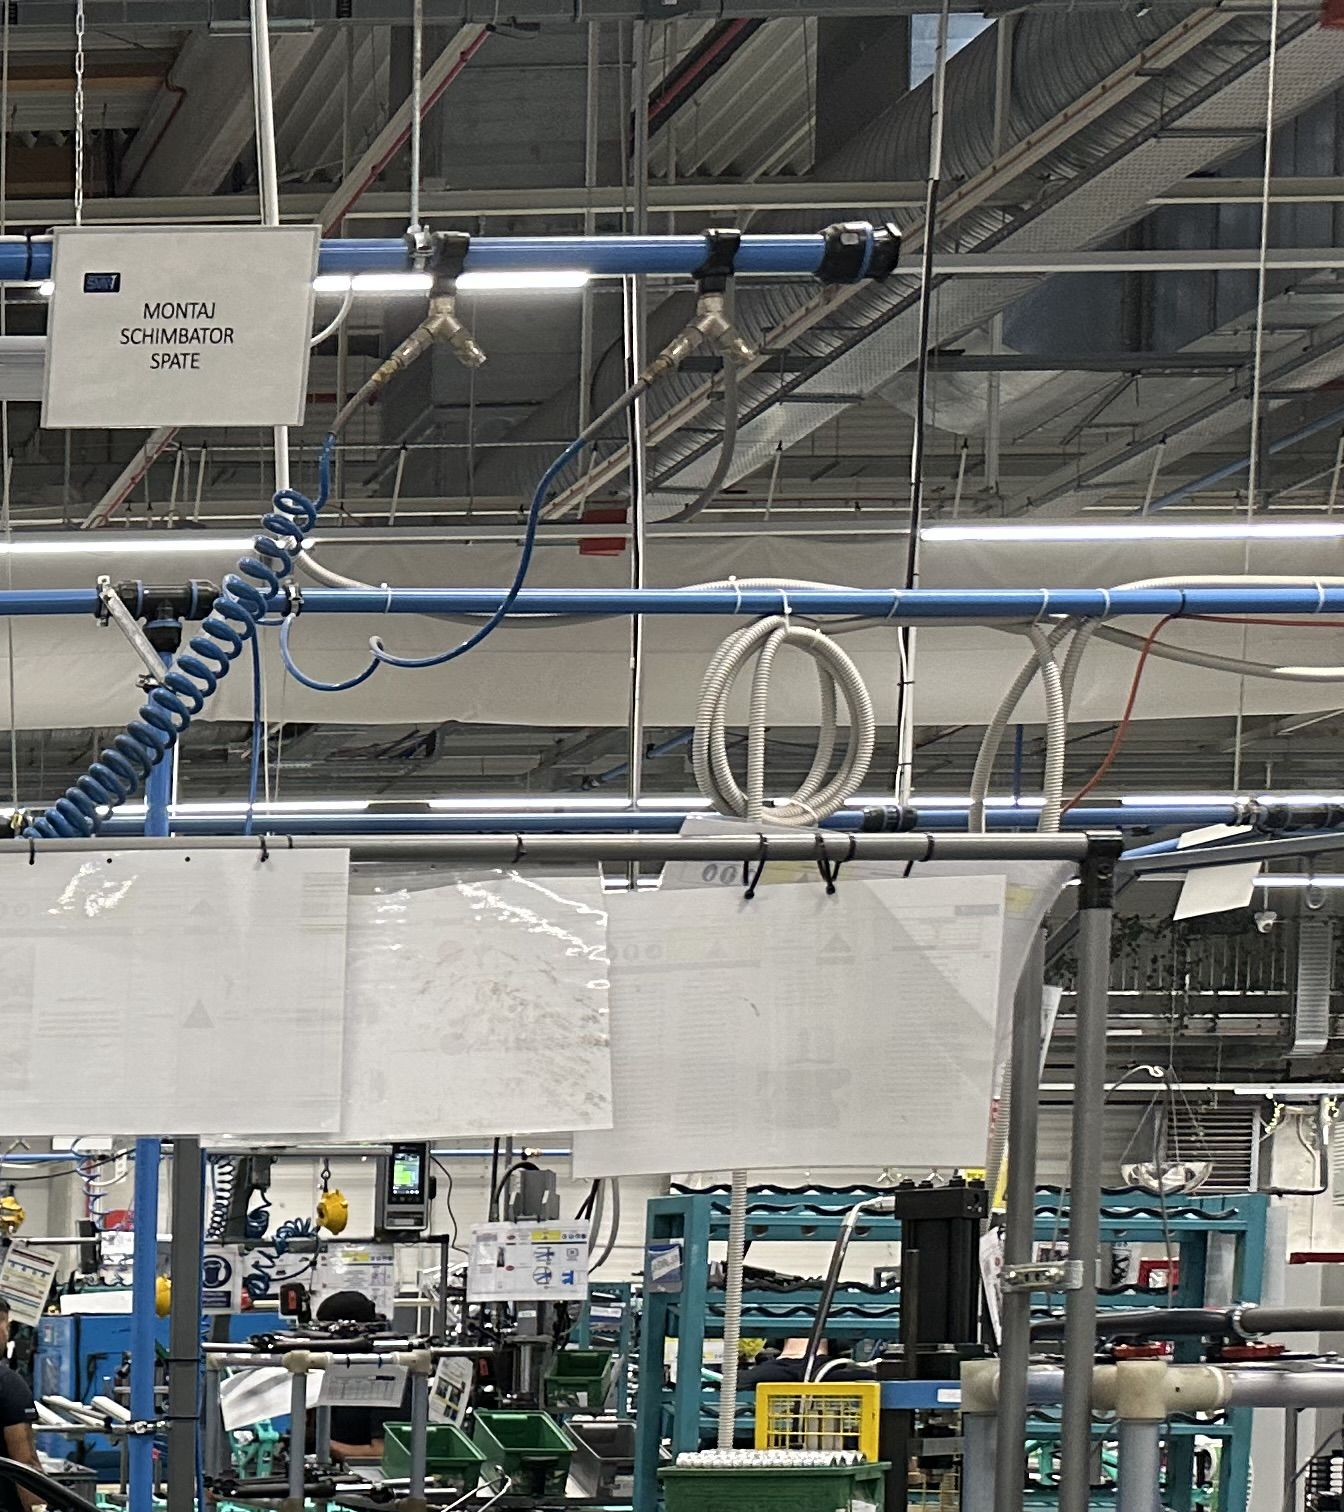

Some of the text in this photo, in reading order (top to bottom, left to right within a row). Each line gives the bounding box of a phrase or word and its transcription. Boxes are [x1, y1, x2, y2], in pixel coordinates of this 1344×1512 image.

[143, 301, 216, 319] MONTAJ
[120, 327, 234, 345] SCHIMBATOR
[150, 352, 200, 369] SPATE
